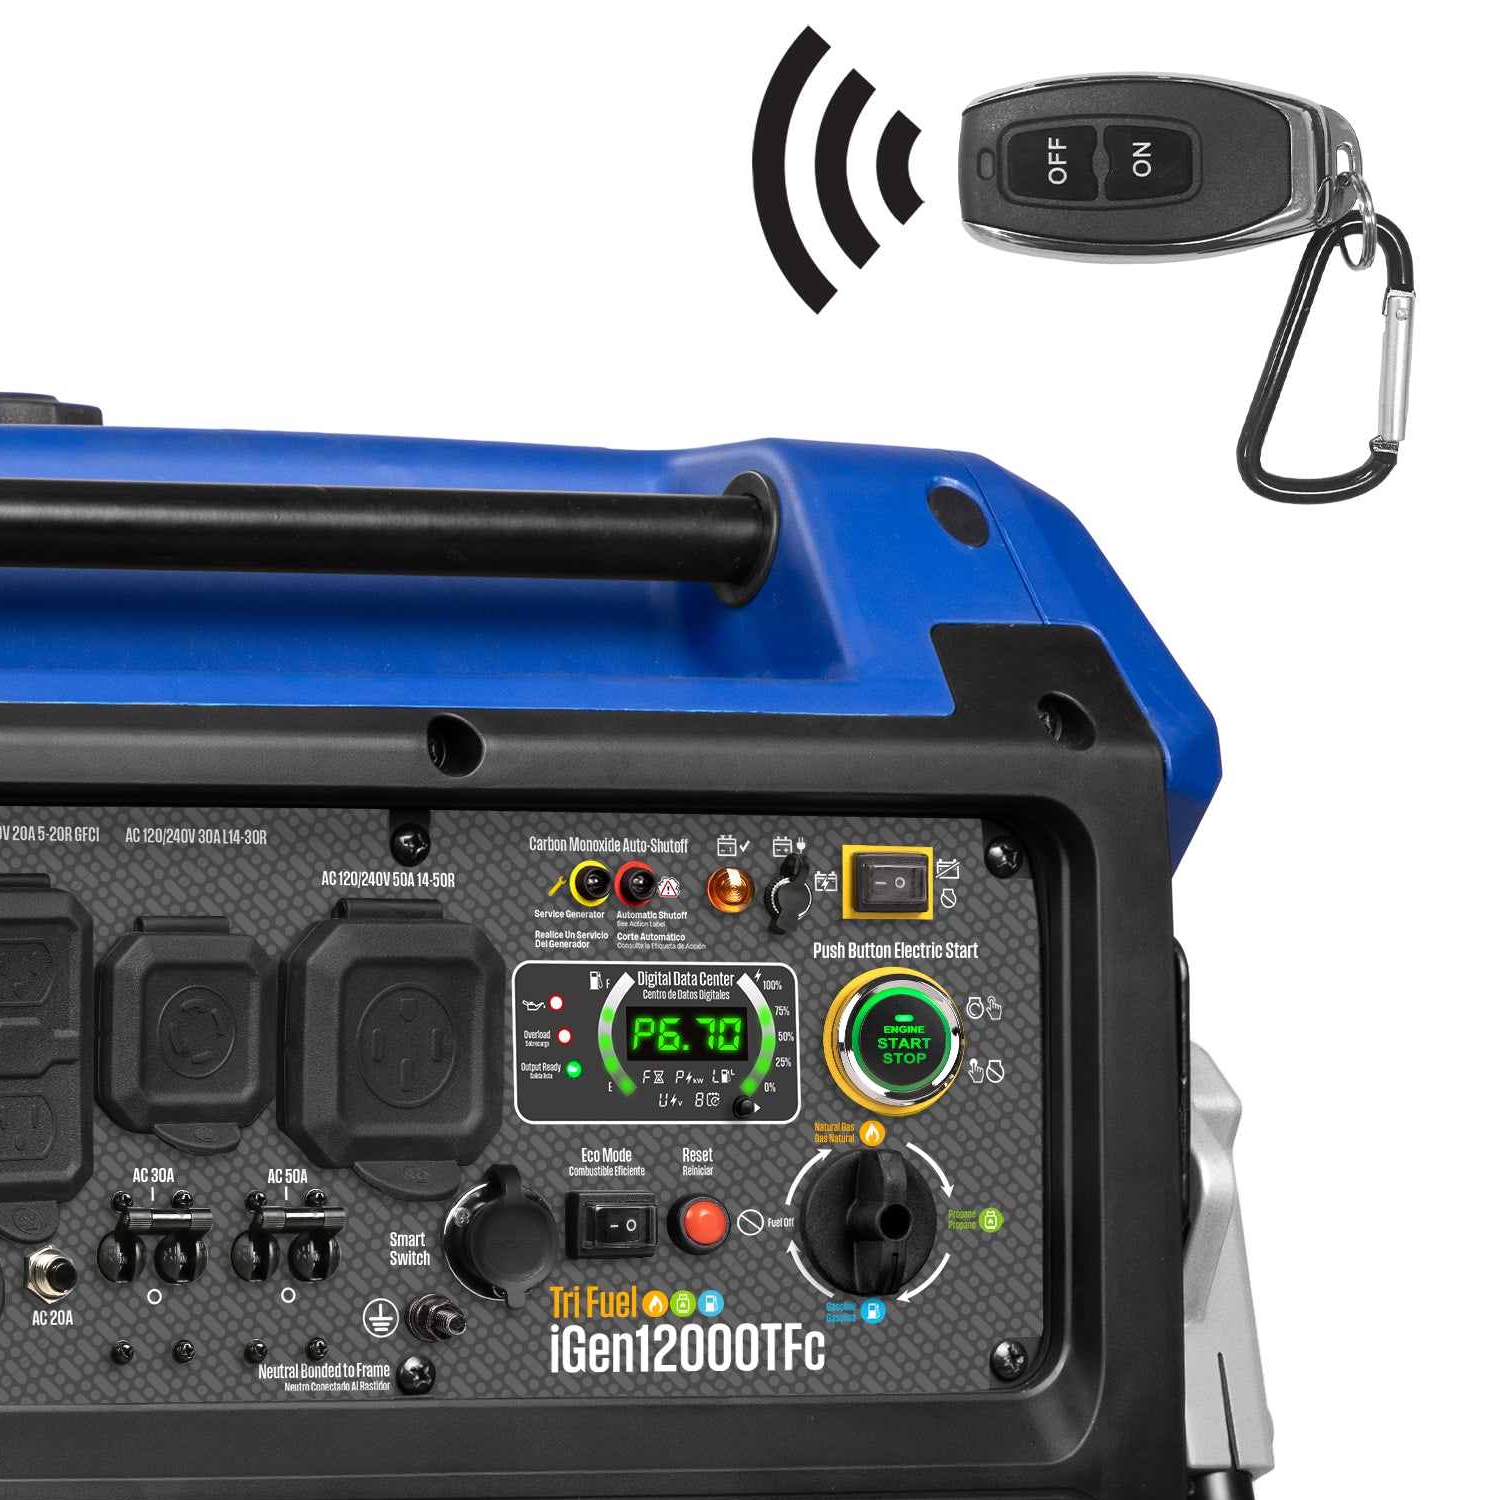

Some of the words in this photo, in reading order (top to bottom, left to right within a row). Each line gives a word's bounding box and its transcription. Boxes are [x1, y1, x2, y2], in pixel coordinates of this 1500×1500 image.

[1048, 137, 1067, 185] OFF
[1133, 141, 1151, 178] ON
[13, 826, 35, 841] 20A
[38, 826, 72, 842] 5-20R
[74, 826, 99, 842] GFCI
[126, 828, 140, 843] AC
[143, 828, 195, 845] 120/240V
[198, 828, 220, 844] 30A
[223, 829, 267, 845] L14-30R
[530, 837, 566, 851] Carbon
[569, 837, 620, 852] Monoxide
[623, 837, 688, 853] Auto-Shutoff
[322, 871, 337, 885] AC
[339, 871, 390, 888] 120/240V
[393, 872, 415, 887] 50A
[417, 872, 455, 888] 14-50R
[535, 910, 564, 918] Service
[566, 910, 605, 918] Generator
[617, 911, 658, 919] Automatic
[659, 911, 687, 920] Shutoff
[535, 931, 564, 939] Realice
[565, 931, 575, 939] Un
[577, 931, 608, 939] Servicio
[640, 932, 685, 941] Automático
[535, 940, 548, 948] Del
[549, 940, 589, 948] Generador
[814, 942, 845, 958] Push
[849, 942, 891, 959] Button
[894, 942, 942, 959] Electric
[946, 942, 978, 959] Start
[606, 979, 610, 989] F
[638, 971, 671, 987] Digital
[674, 971, 696, 986] Data
[699, 972, 734, 987] Center
[763, 981, 782, 991] 100%
[643, 989, 666, 999] Centro
[668, 990, 676, 999] de
[678, 990, 698, 1000] Datos
[699, 990, 729, 1001] Digitales
[775, 1006, 789, 1016] 75%
[524, 1030, 550, 1039] Overload
[633, 1017, 742, 1051] P6.70
[883, 1025, 925, 1033] ENGINE
[778, 1032, 794, 1042] 50%
[877, 1037, 931, 1049] START
[776, 1058, 791, 1067] 25%
[883, 1052, 927, 1064] STOP
[521, 1062, 541, 1072] Output
[543, 1062, 561, 1072] Ready
[608, 1082, 612, 1092] E
[764, 1082, 776, 1092] 0%
[815, 1122, 838, 1132] Natural
[840, 1122, 854, 1132] Gas
[815, 1133, 828, 1143] Gas
[830, 1133, 854, 1143] Natural
[582, 1148, 599, 1162] Eco
[602, 1148, 631, 1162] Mode
[683, 1147, 713, 1162] Reset
[133, 1168, 148, 1183] AC
[151, 1168, 174, 1183] 30A
[569, 1165, 613, 1177] Combustible
[614, 1165, 645, 1177] Eficiente
[683, 1165, 713, 1176] Reiniciar
[268, 1169, 283, 1184] AC
[285, 1169, 308, 1184] 50A
[948, 1210, 976, 1220] Propane
[768, 1218, 782, 1227] Fuel
[784, 1218, 794, 1227] Off
[948, 1221, 976, 1231] Propano
[390, 1231, 426, 1247] Smart
[390, 1250, 430, 1266] Switch
[550, 1286, 583, 1318] Tri
[588, 1286, 637, 1318] Fuel
[826, 1302, 856, 1311] Gasoline
[32, 1310, 48, 1326] AC
[50, 1310, 73, 1326] 20A
[826, 1313, 856, 1323] Gasolina
[551, 1322, 825, 1373] iGen12000TFc
[259, 1363, 298, 1379] Neutral
[301, 1363, 341, 1378] Bonded
[343, 1363, 354, 1377] to
[357, 1362, 390, 1377] Frame
[285, 1382, 309, 1391] Neutro
[311, 1381, 350, 1391] Conectado
[351, 1381, 358, 1391] Al
[360, 1381, 390, 1391] Bastidor
